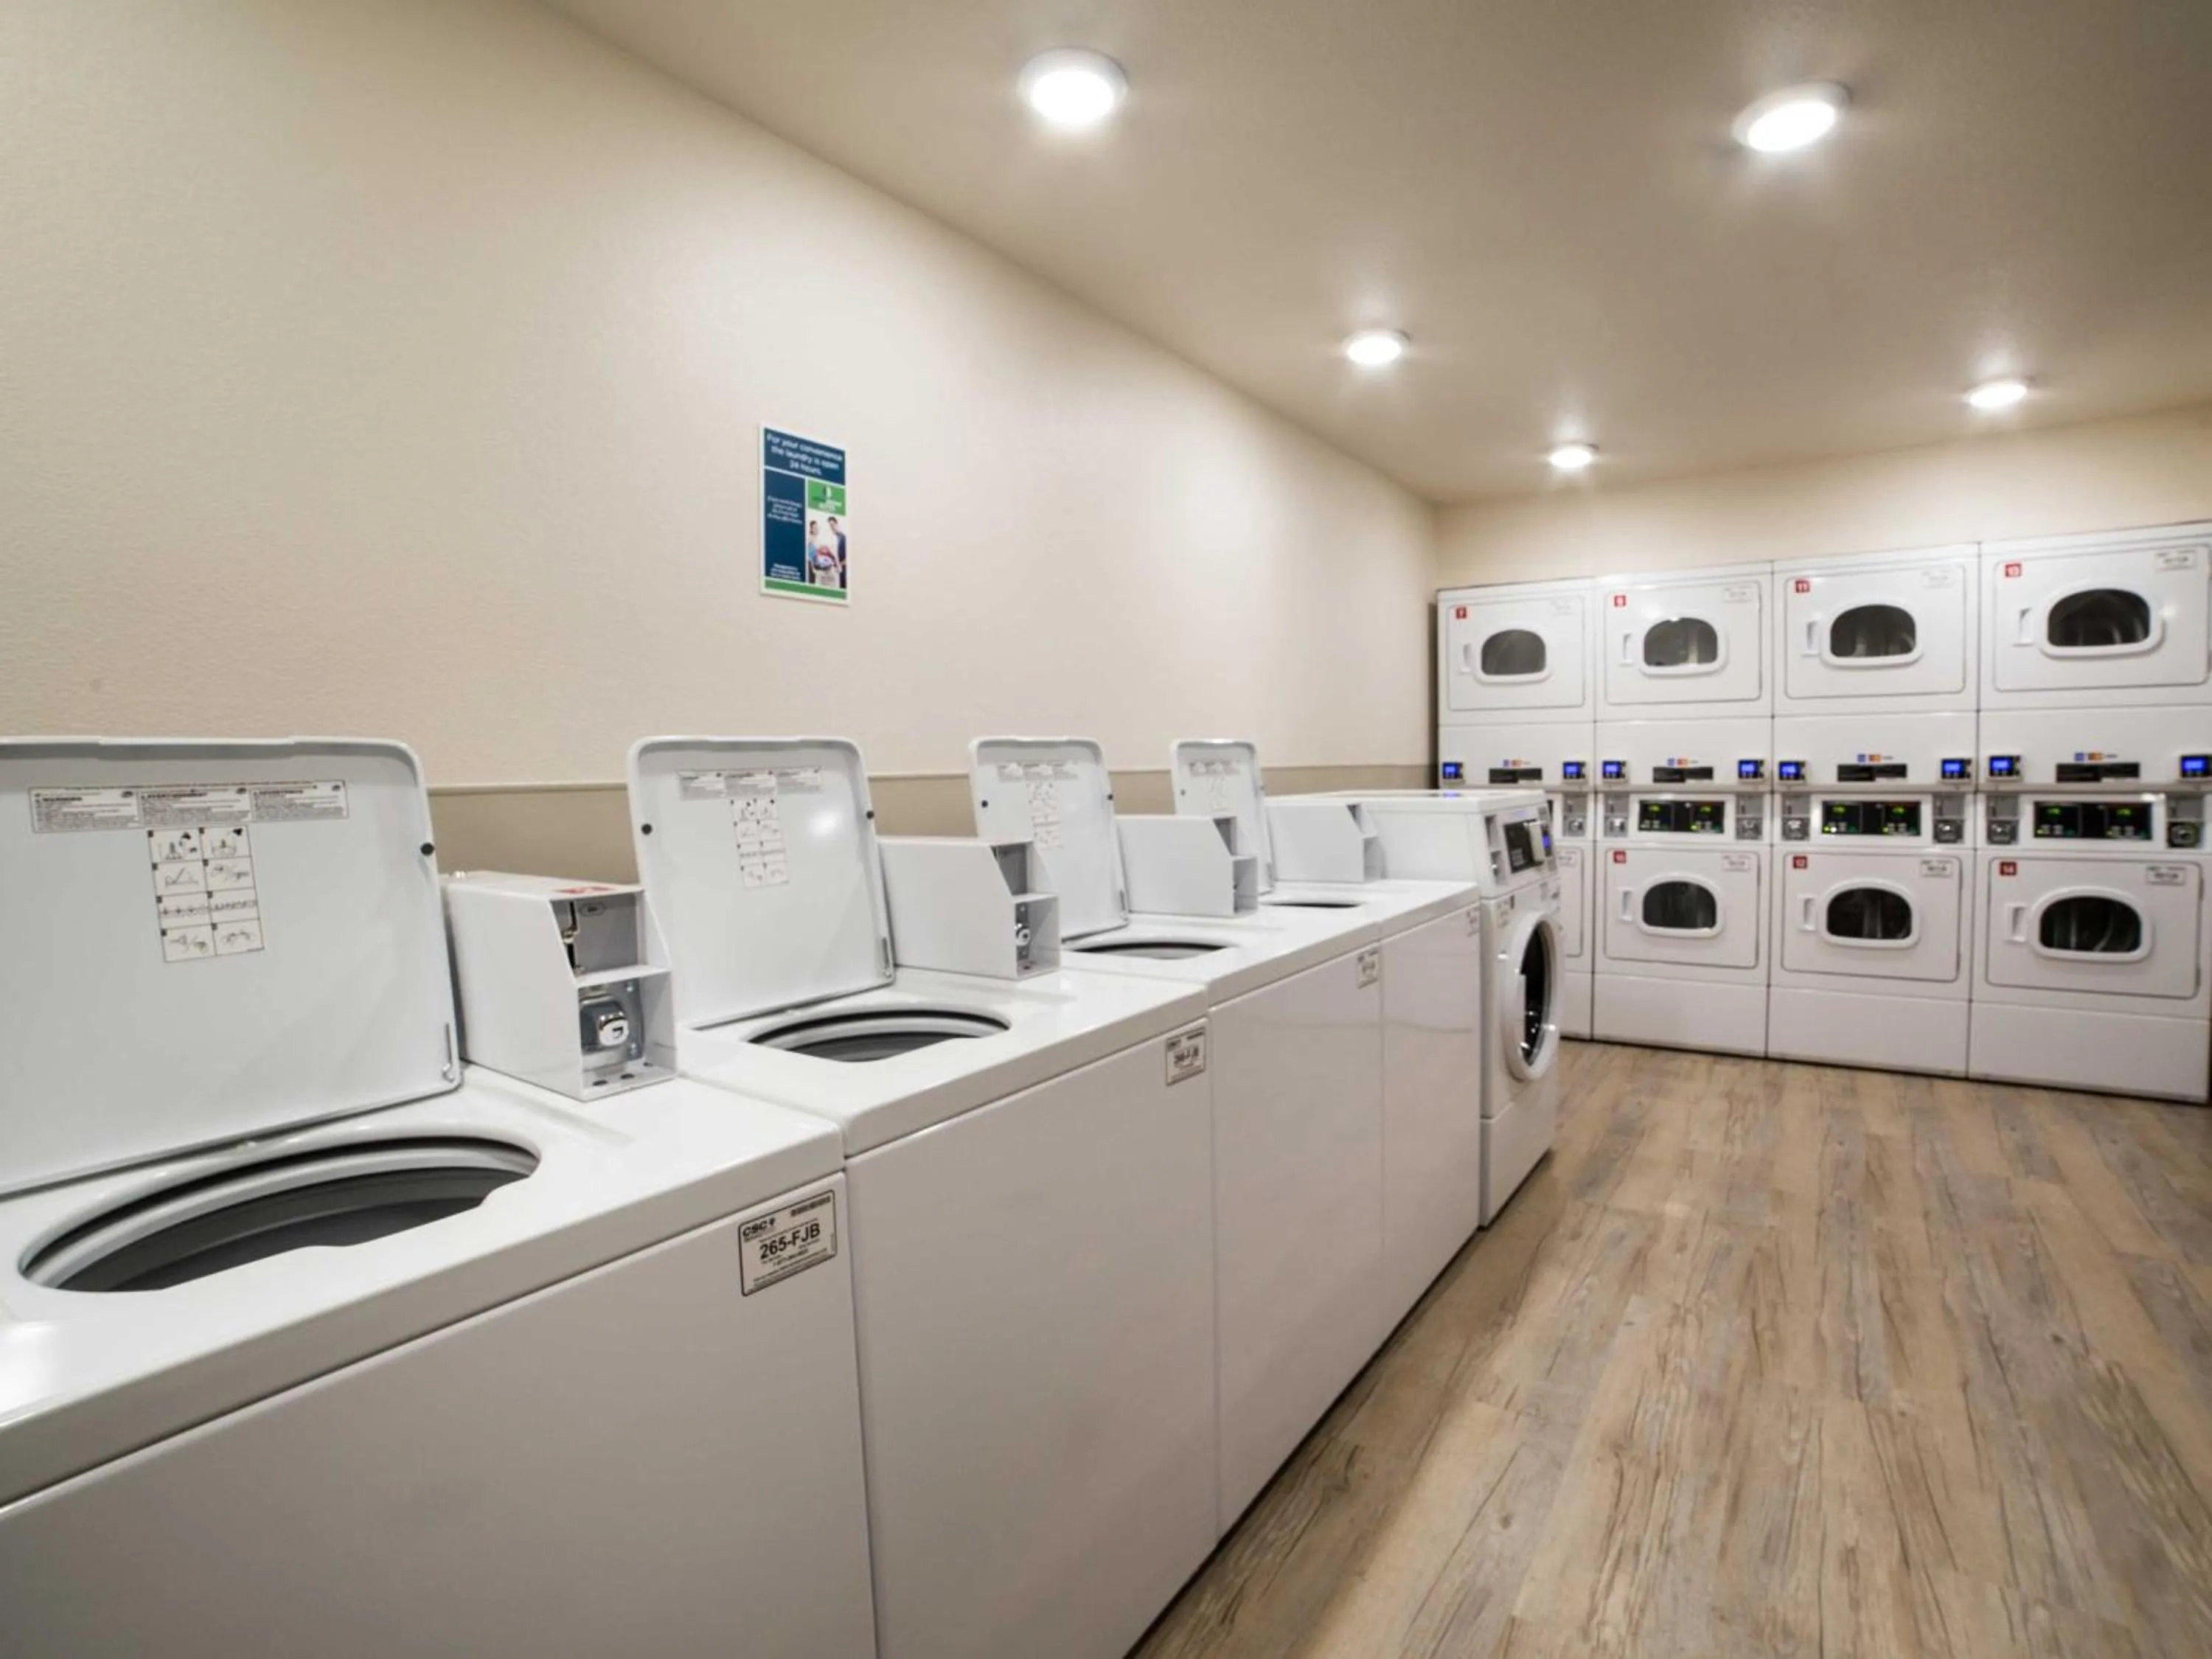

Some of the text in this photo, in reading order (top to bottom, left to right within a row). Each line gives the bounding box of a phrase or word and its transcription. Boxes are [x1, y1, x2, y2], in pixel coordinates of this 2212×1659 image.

[767, 433, 843, 461] For your convenience
[771, 445, 785, 456] the
[785, 448, 813, 465] laundry
[821, 460, 839, 470] open
[759, 1222, 821, 1259] 265-FJB
